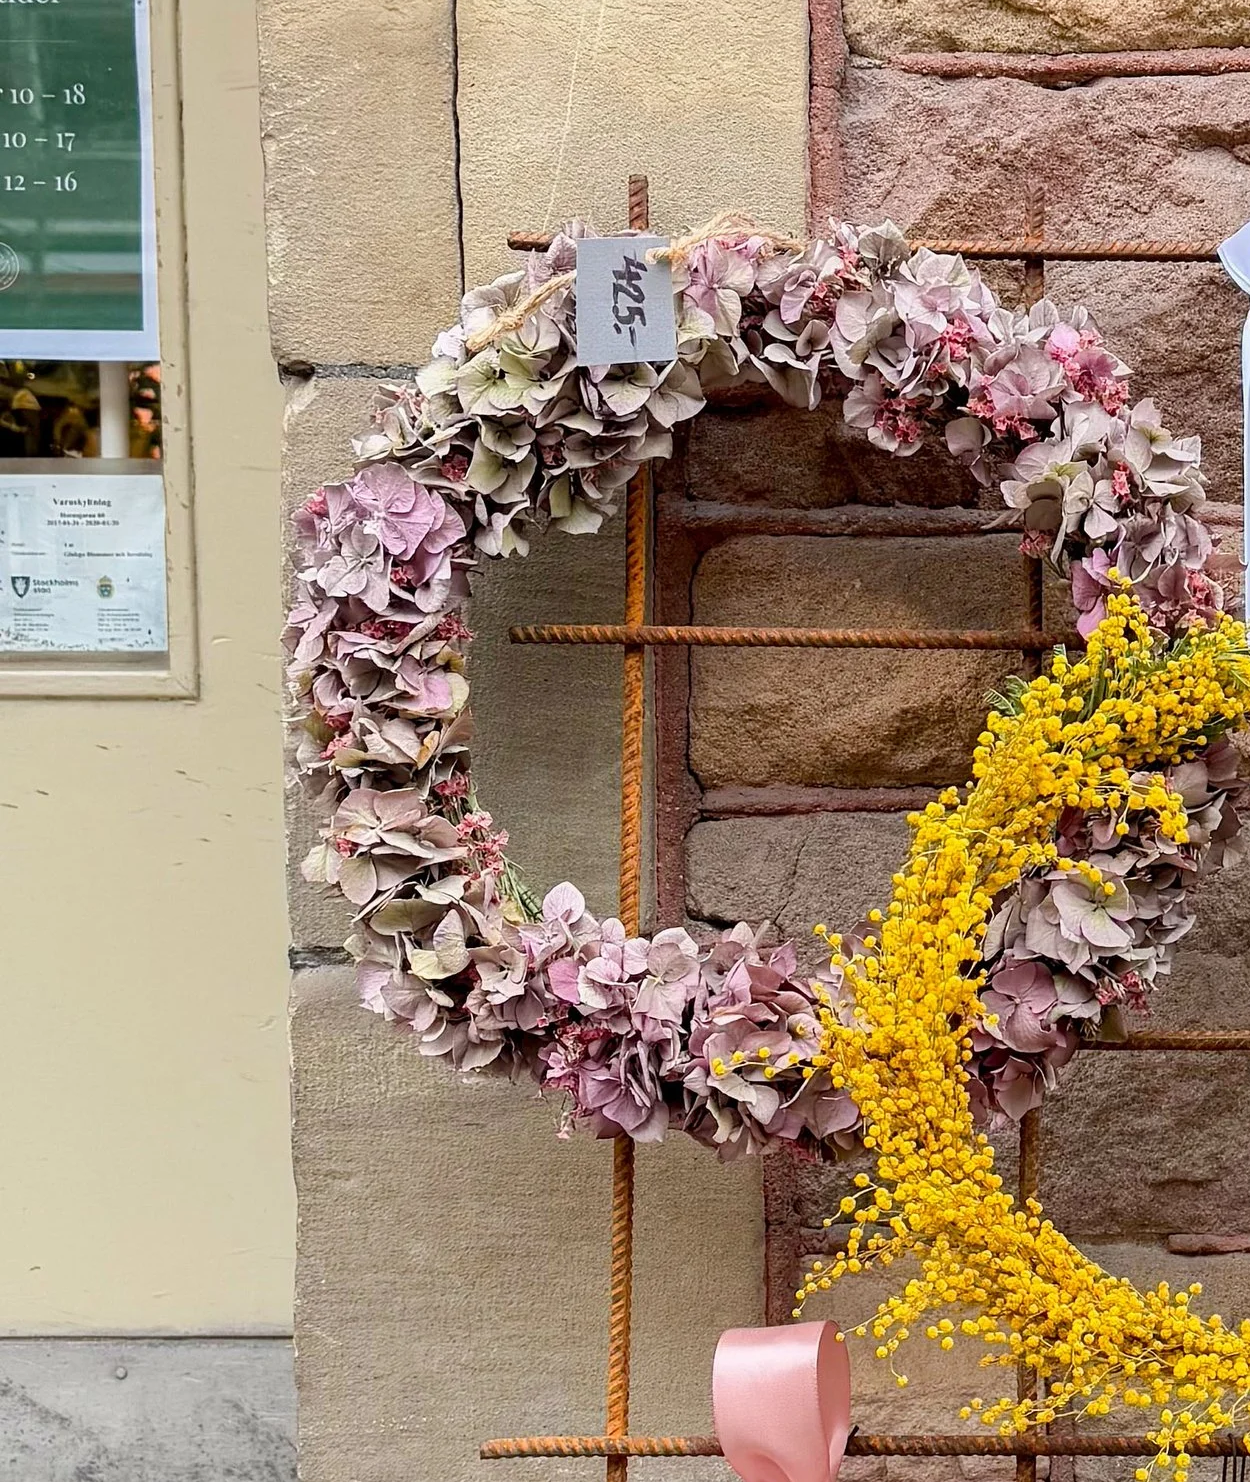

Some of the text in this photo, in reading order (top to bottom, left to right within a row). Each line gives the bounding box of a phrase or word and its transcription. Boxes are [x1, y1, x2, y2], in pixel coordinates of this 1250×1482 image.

[10, 88, 34, 104] 10
[64, 83, 86, 105] 18
[3, 132, 27, 148] 10
[56, 132, 76, 151] 17
[4, 175, 26, 191] 12
[55, 171, 78, 192] 16
[32, 579, 80, 587] Stockholms
